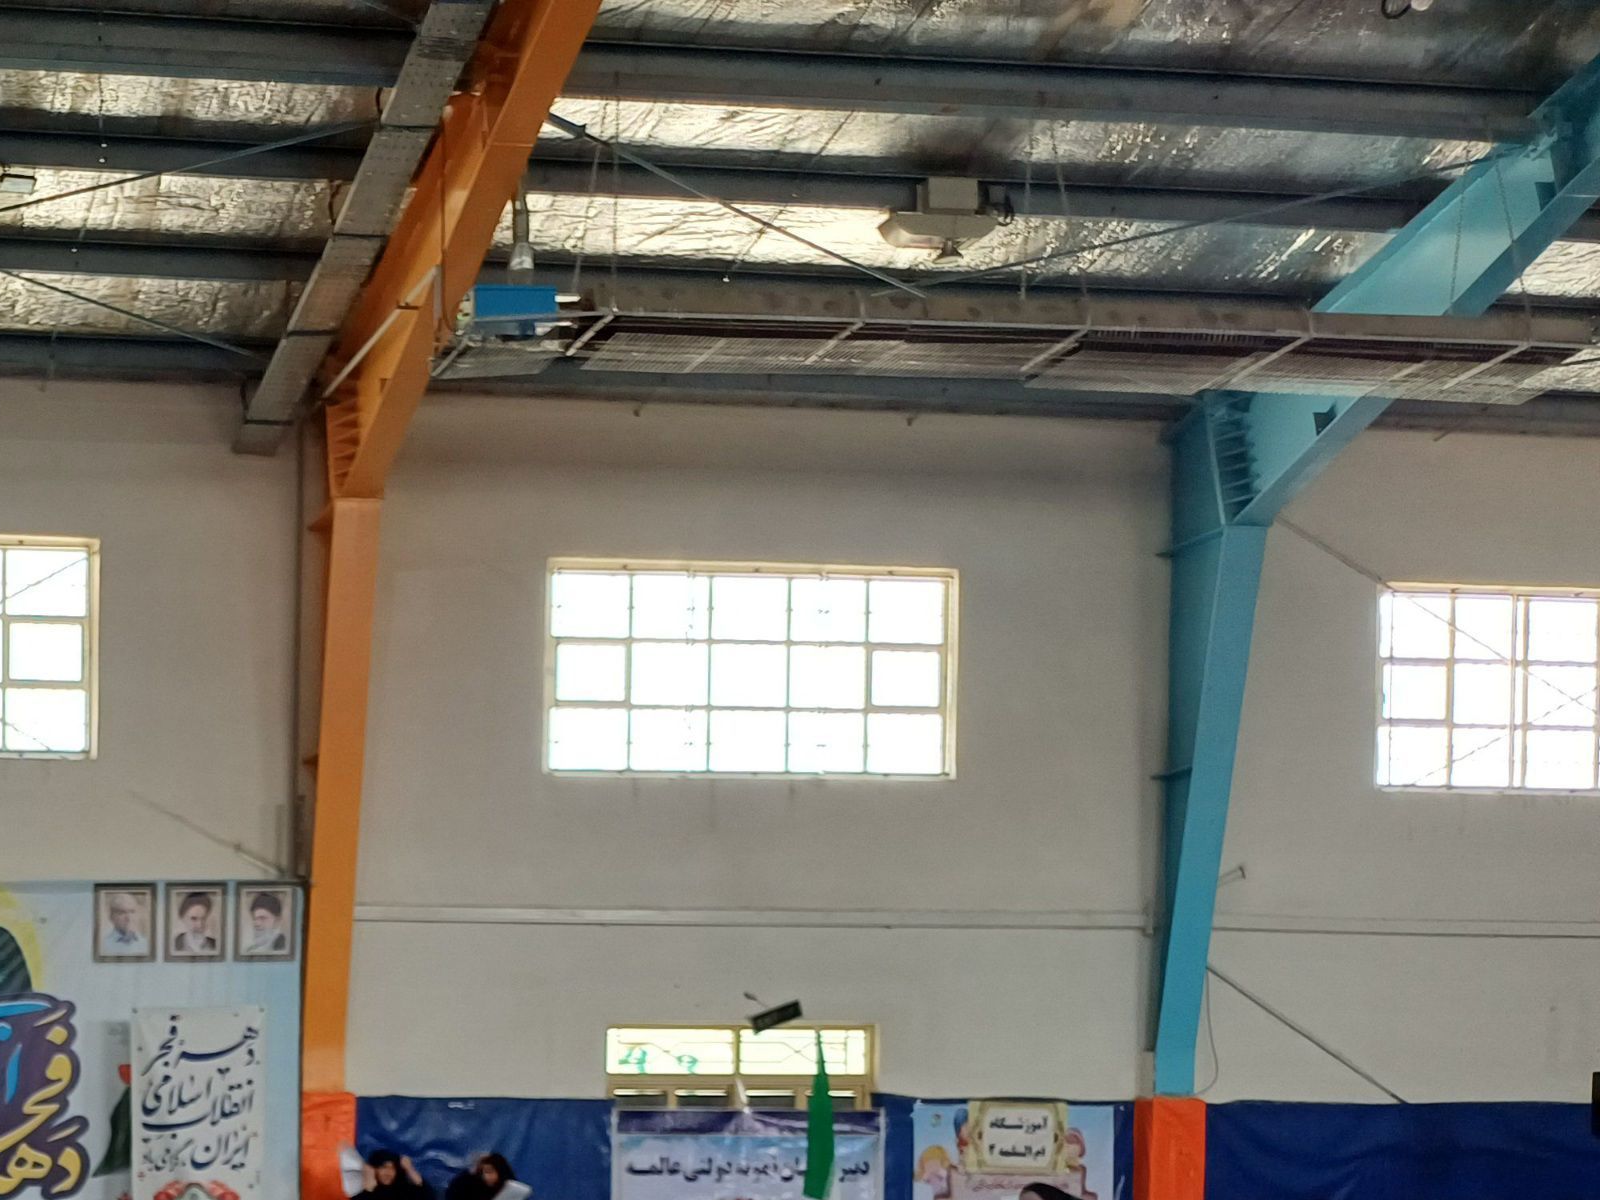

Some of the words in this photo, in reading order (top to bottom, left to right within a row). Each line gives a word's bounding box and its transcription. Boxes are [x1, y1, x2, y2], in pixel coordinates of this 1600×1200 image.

[141, 1074, 213, 1118] اسلامی
[141, 1080, 255, 1132] انقلاب
[190, 1132, 250, 1171] ایران
